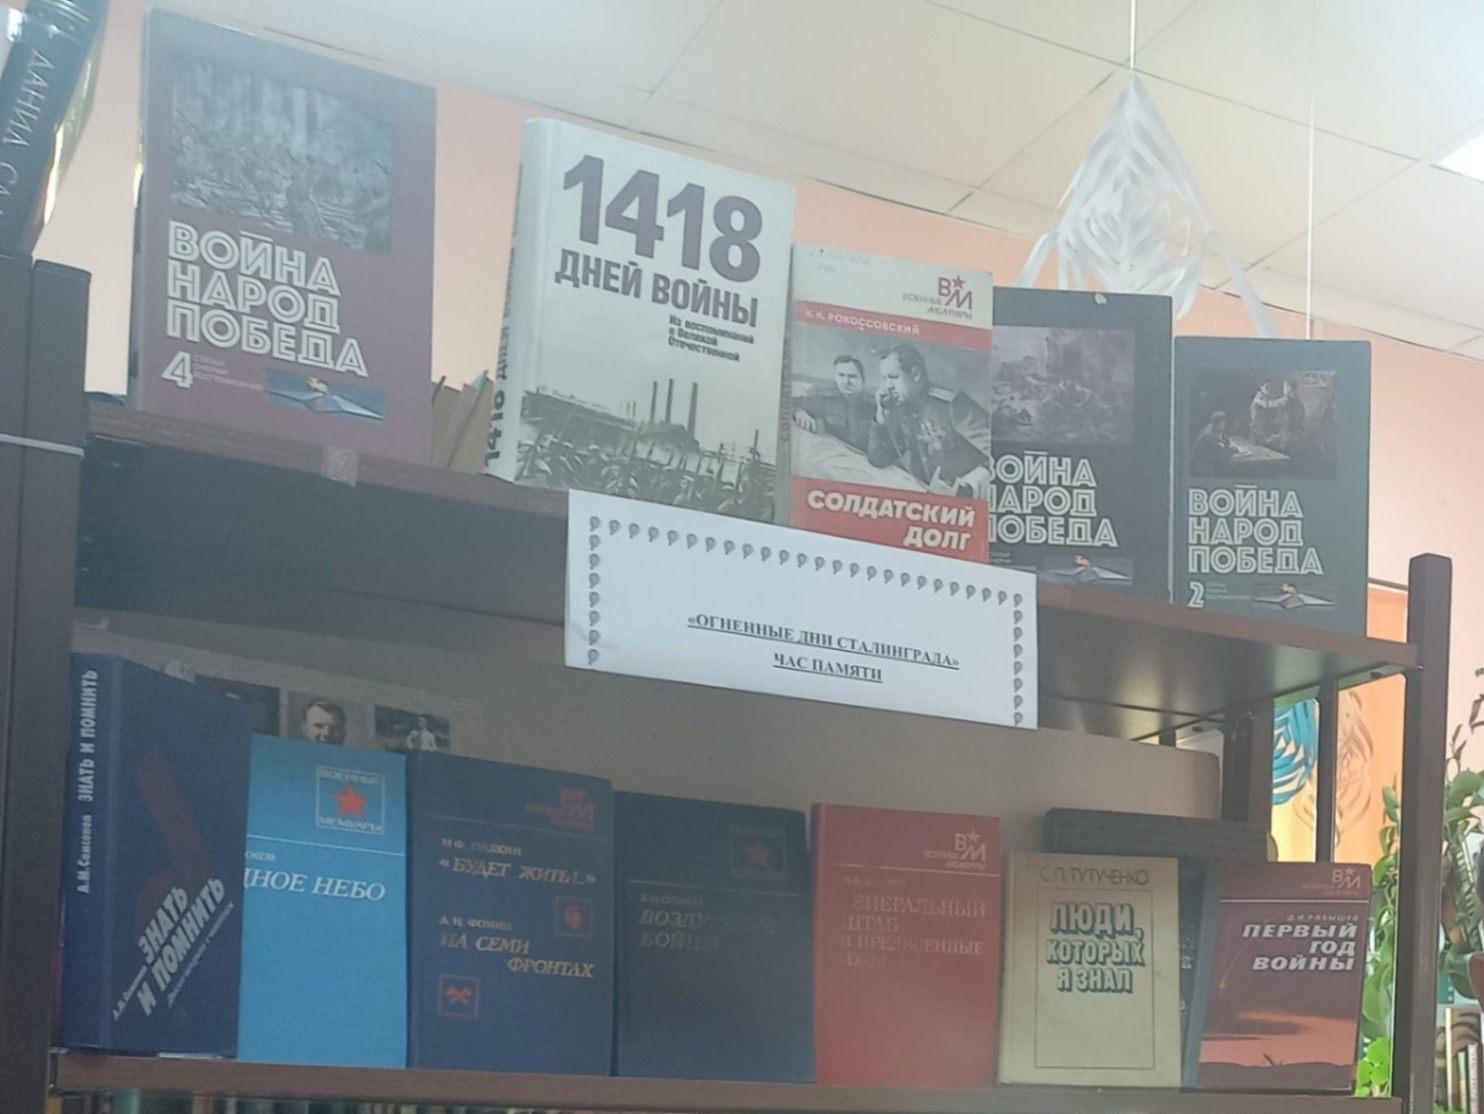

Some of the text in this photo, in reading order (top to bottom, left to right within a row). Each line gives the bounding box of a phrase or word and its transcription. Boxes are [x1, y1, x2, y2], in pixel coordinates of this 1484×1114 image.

[562, 154, 764, 283] 1418
[168, 220, 342, 297] ВОЙНА
[167, 260, 340, 334] НАРОД
[555, 247, 643, 300] ДНЕЙ
[651, 271, 759, 328] ВОЙНЫ
[167, 300, 369, 378] ПОБЕДА
[161, 351, 194, 389] 4
[806, 489, 976, 529] СОЛДАТСКИЙ
[1188, 484, 1304, 518] ВОЙНА
[903, 525, 972, 551] ДОЛГ
[1188, 517, 1303, 547] НАРОД
[1188, 546, 1324, 575] ПОБЕДА
[1188, 581, 1205, 609] 2
[688, 612, 961, 669] «ОГНЕННЫЕ ДНИ СТАЛИНГРАДА»
[773, 652, 883, 683] ЧАС ПАМЯТИ
[79, 668, 98, 740] ПОМНИТЬ
[80, 741, 96, 755] И
[78, 757, 96, 802] ЗНАТЬ
[311, 875, 387, 902] НЕБО
[138, 883, 190, 967] ЗНАТЬ
[151, 876, 227, 989] ПОМНИТЬ
[1050, 902, 1145, 941] ЛЮДИ,
[1242, 922, 1359, 939] ПЕРВЫЙ
[474, 936, 531, 956] СЕМИ
[1046, 939, 1146, 968] КОТОРЫХ
[1309, 940, 1357, 958] ГОД
[505, 956, 596, 979] ФРОНТАХ
[1252, 954, 1355, 972] ВОЙНЫ
[1056, 967, 1134, 994] Я ЗНАЛ
